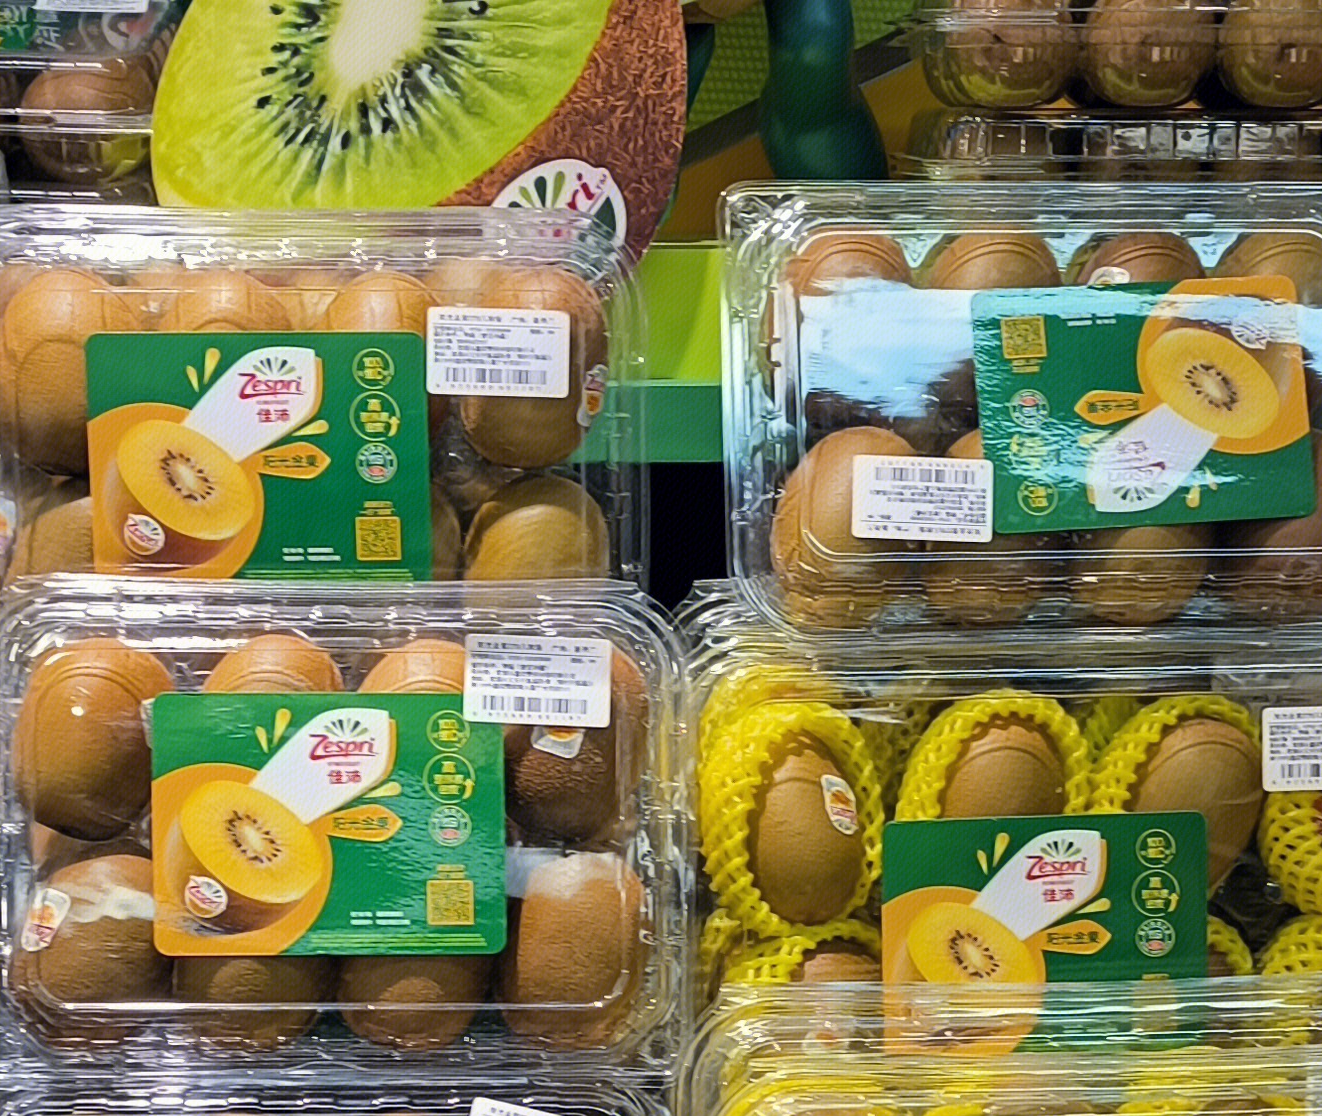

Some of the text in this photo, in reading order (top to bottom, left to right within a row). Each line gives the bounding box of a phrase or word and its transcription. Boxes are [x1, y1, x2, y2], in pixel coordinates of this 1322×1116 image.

[237, 372, 307, 399] Zespri
[308, 733, 379, 760] Zespri
[326, 769, 363, 785] 佳沛
[1025, 855, 1091, 882] Zespri
[1041, 887, 1076, 904] 佳沛
